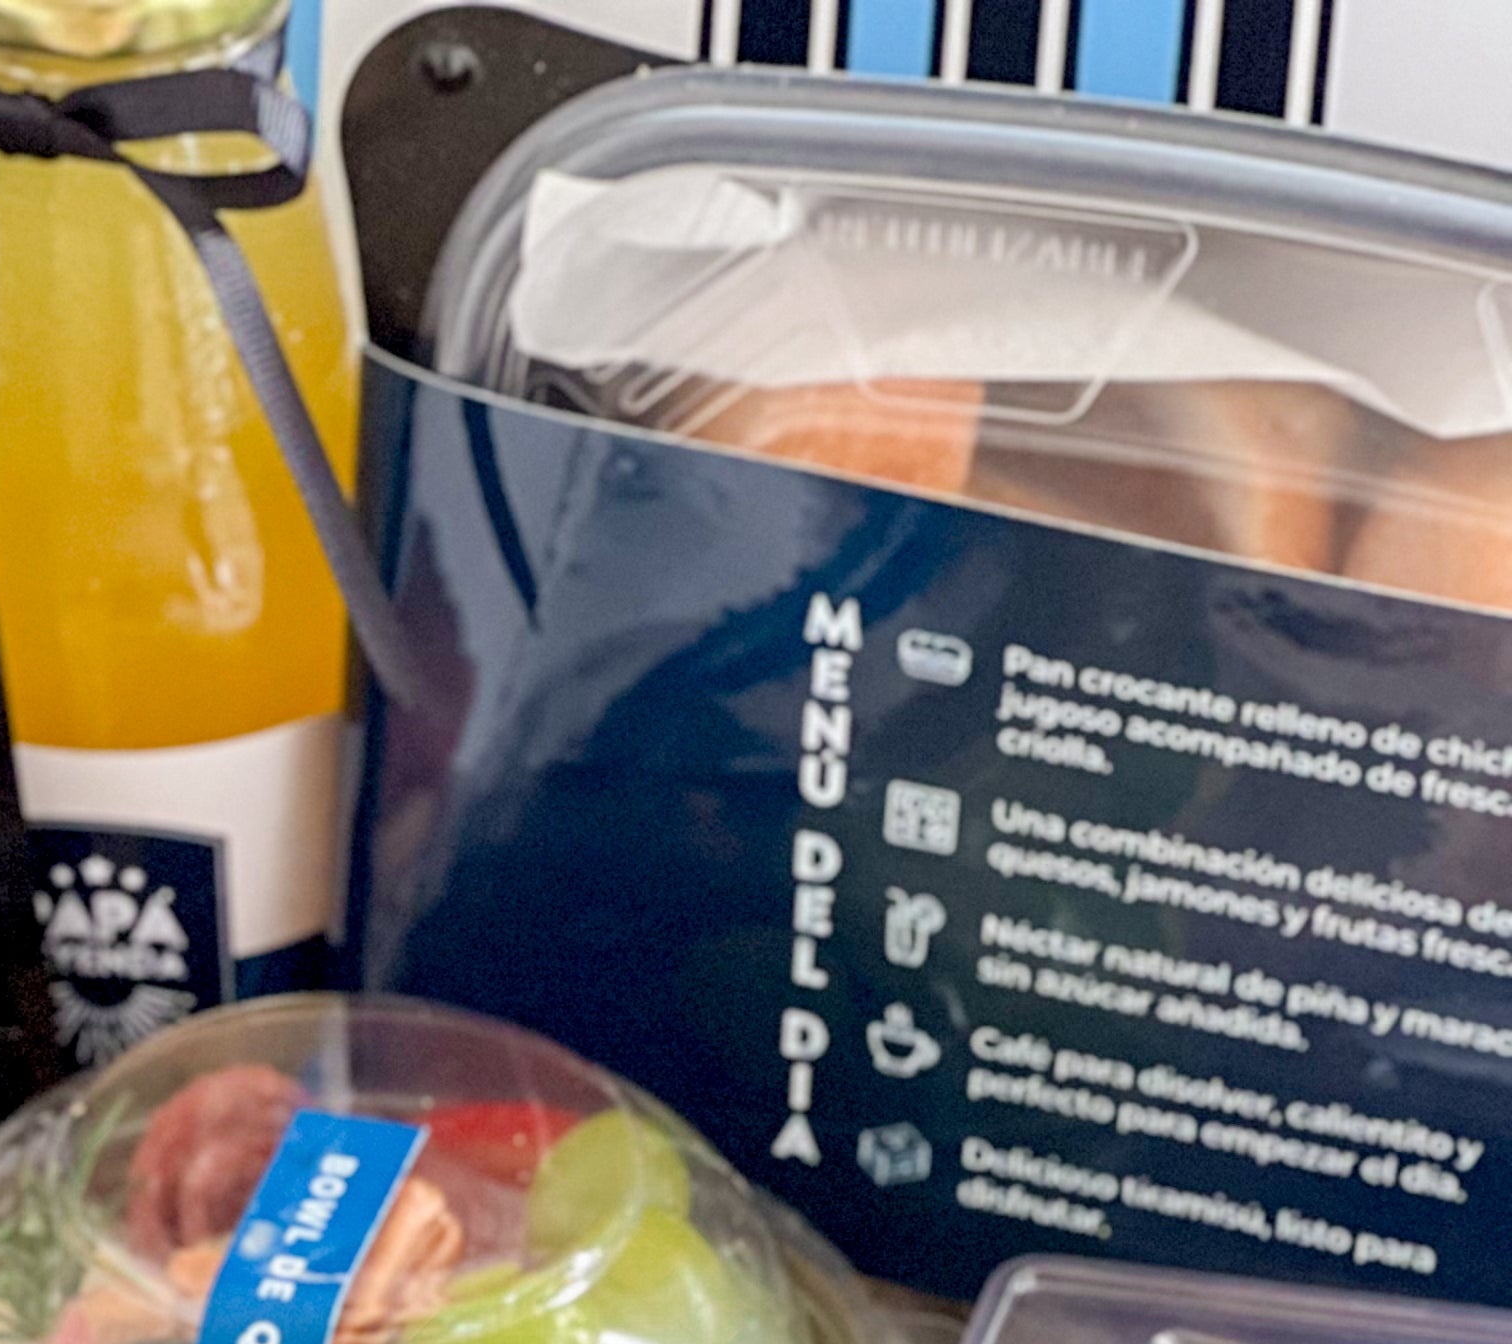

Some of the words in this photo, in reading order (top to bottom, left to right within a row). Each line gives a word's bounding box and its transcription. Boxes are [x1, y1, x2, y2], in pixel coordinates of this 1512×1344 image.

[798, 591, 863, 808] MENÚ
[996, 681, 1123, 737] jugoso
[1125, 713, 1362, 787] acompañado
[1365, 762, 1416, 798] de
[1420, 769, 1512, 817] fresc
[996, 726, 1114, 775] criolla.
[1003, 643, 1074, 689] Pan
[1078, 666, 1237, 722] crocante
[1240, 701, 1368, 749] relleno
[1371, 723, 1422, 760] de
[791, 828, 843, 990] DEL
[986, 841, 1121, 898] quesos,
[1122, 862, 1280, 929] jamones
[1280, 903, 1311, 938] y
[1310, 903, 1419, 958] frutas
[1421, 928, 1512, 977] fresc
[991, 797, 1066, 843] Una
[1069, 818, 1301, 892] combinación
[1305, 865, 1463, 927] deliciosa
[1466, 901, 1512, 939] de
[976, 952, 1033, 992] sin
[1034, 966, 1155, 1017] azúcar
[1155, 993, 1311, 1053] añadida.
[980, 912, 1101, 966] Néctar
[1102, 944, 1231, 996] natural
[1234, 965, 1285, 1007] de
[1287, 981, 1370, 1030] piña
[1369, 1000, 1401, 1037] y
[966, 1066, 1115, 1125] perfecto
[1116, 1101, 1198, 1143] para
[1199, 1121, 1359, 1178] empezar
[1358, 1153, 1399, 1188] el
[1398, 1161, 1468, 1204] día.
[969, 1025, 1053, 1072] Café
[1053, 1049, 1135, 1089] para
[1137, 1064, 1283, 1127] disolver,
[1452, 1136, 1485, 1173] y
[285, 1152, 359, 1244] BOWL
[956, 1174, 1113, 1240] disfrutar.
[960, 1135, 1120, 1202] Delicioso
[1120, 1173, 1273, 1241] tiramisú,
[1273, 1207, 1352, 1255] listo
[1352, 1231, 1437, 1274] para
[257, 1255, 310, 1303] DE
